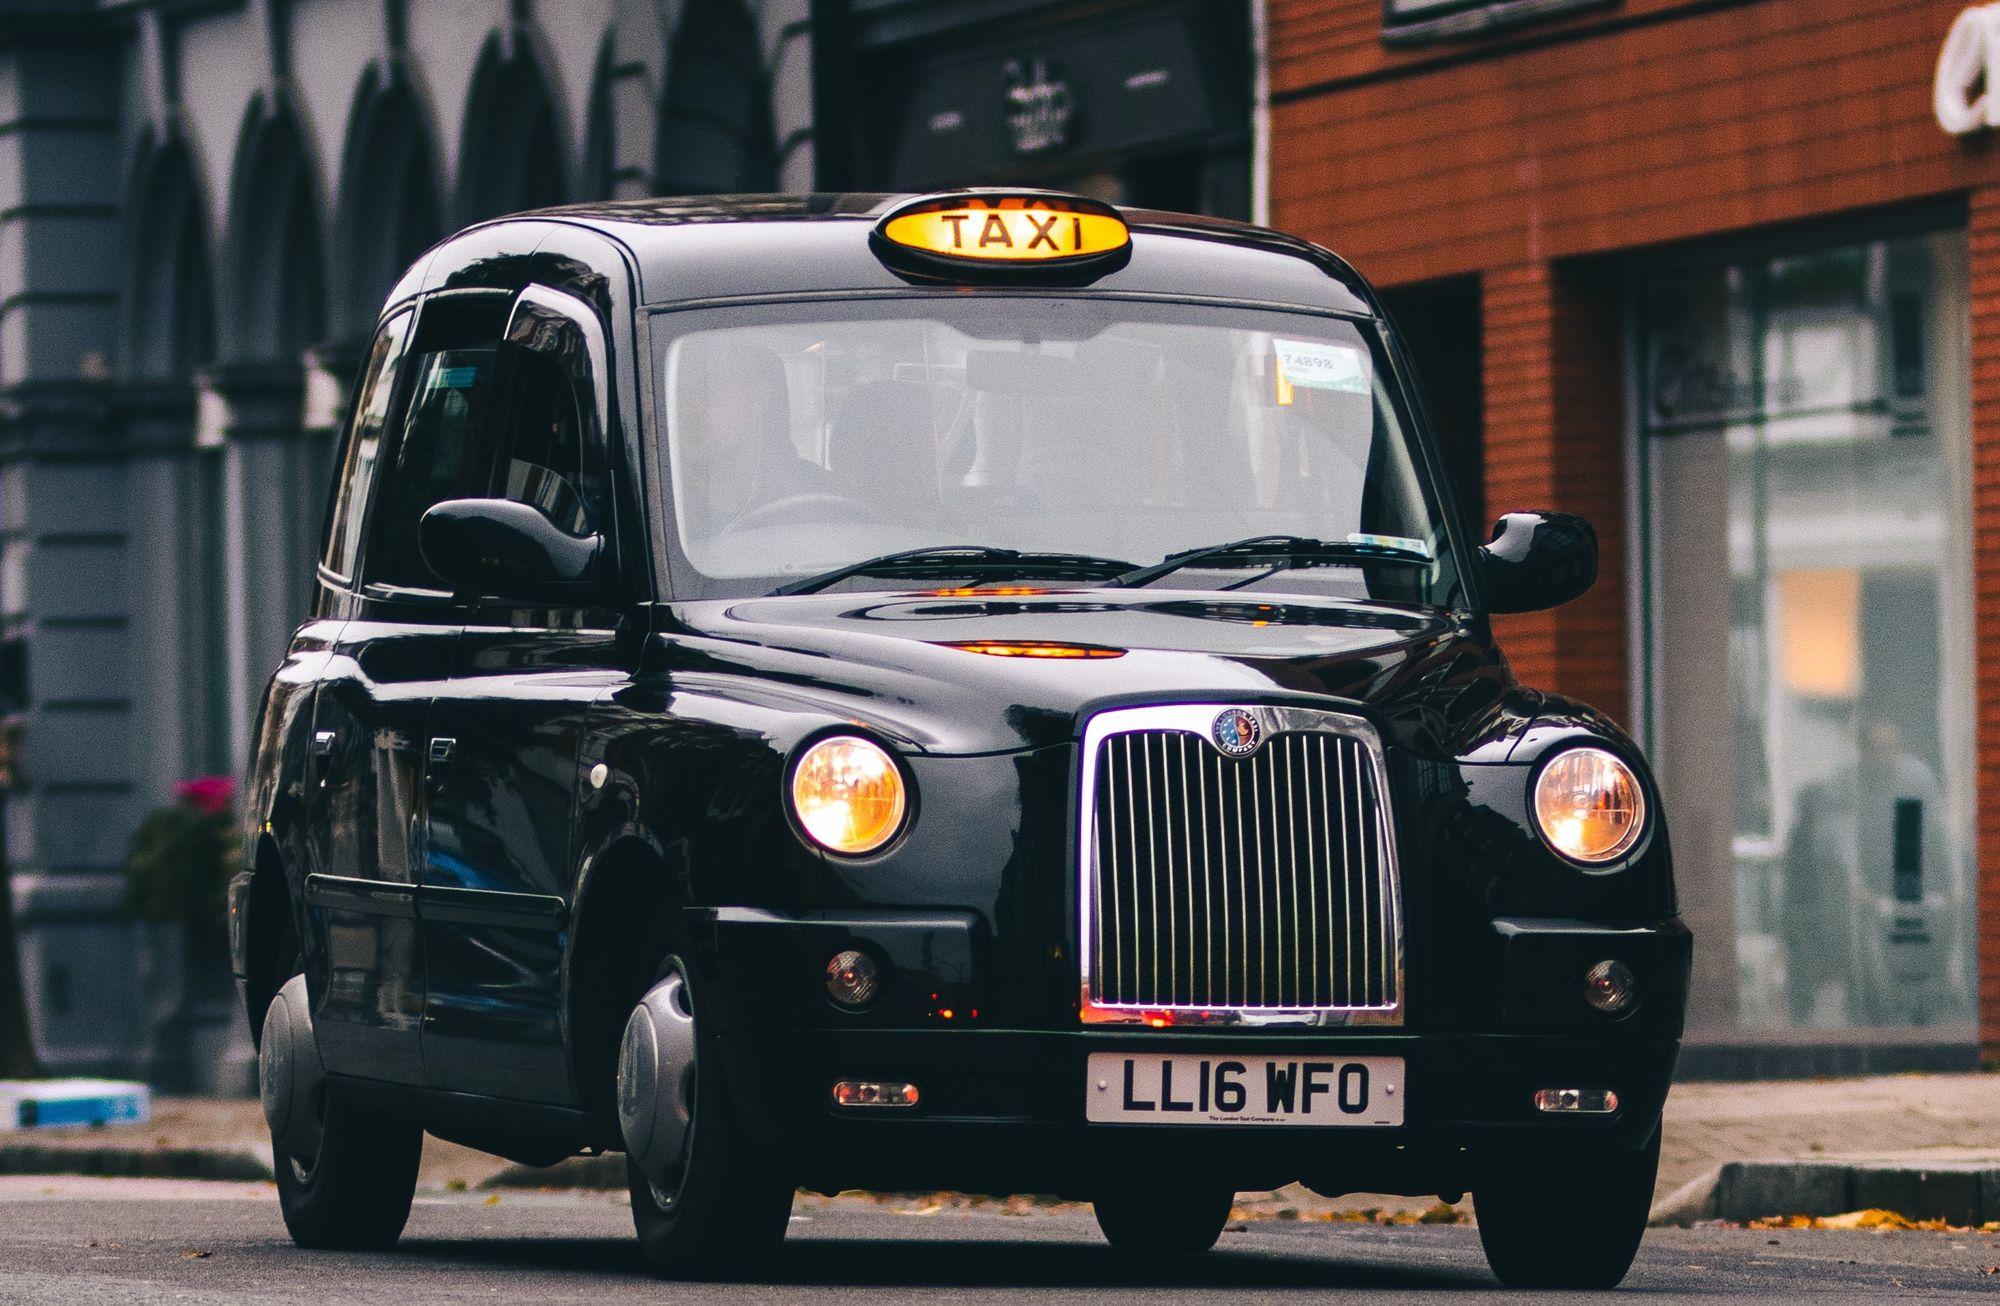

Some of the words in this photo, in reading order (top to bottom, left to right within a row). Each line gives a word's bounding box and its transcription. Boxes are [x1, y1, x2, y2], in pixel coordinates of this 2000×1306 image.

[941, 214, 1082, 251] TAXI
[1123, 1059, 1247, 1112] LL16
[1265, 1062, 1369, 1114] WFO
